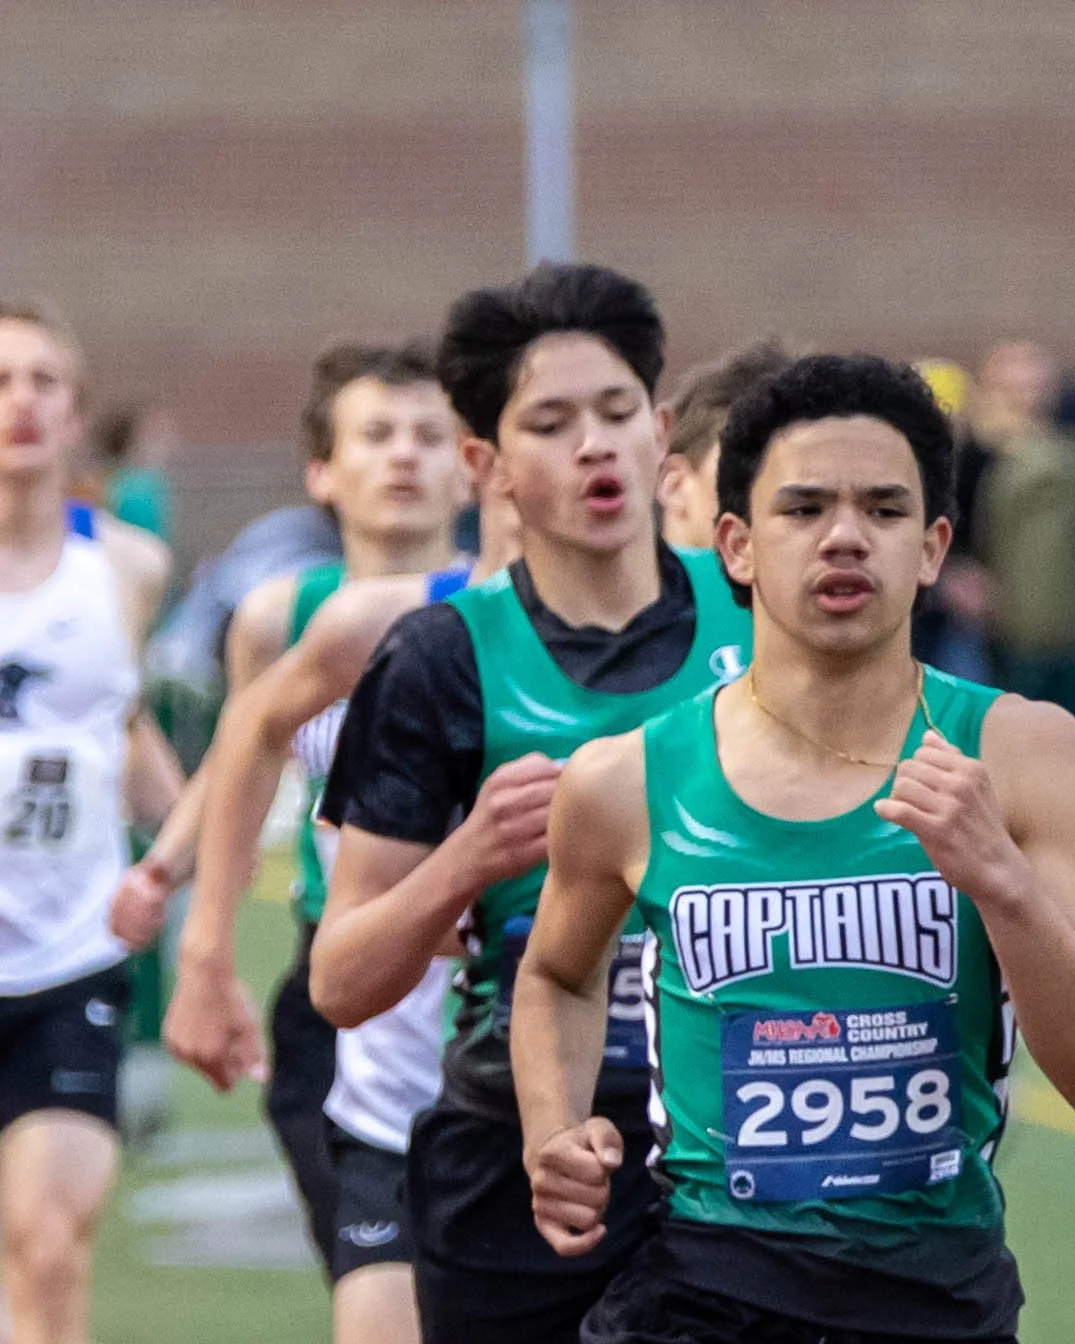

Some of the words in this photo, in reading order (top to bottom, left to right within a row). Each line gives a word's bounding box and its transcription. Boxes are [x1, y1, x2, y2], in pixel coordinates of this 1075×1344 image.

[669, 872, 957, 995] CAPTAINS
[846, 1011, 907, 1028] CROSS
[847, 1022, 928, 1042] COUNTRY
[789, 1047, 848, 1064] REGIONAL
[851, 1038, 938, 1062] CHAMPIONSHIP
[736, 1069, 952, 1147] 2958
